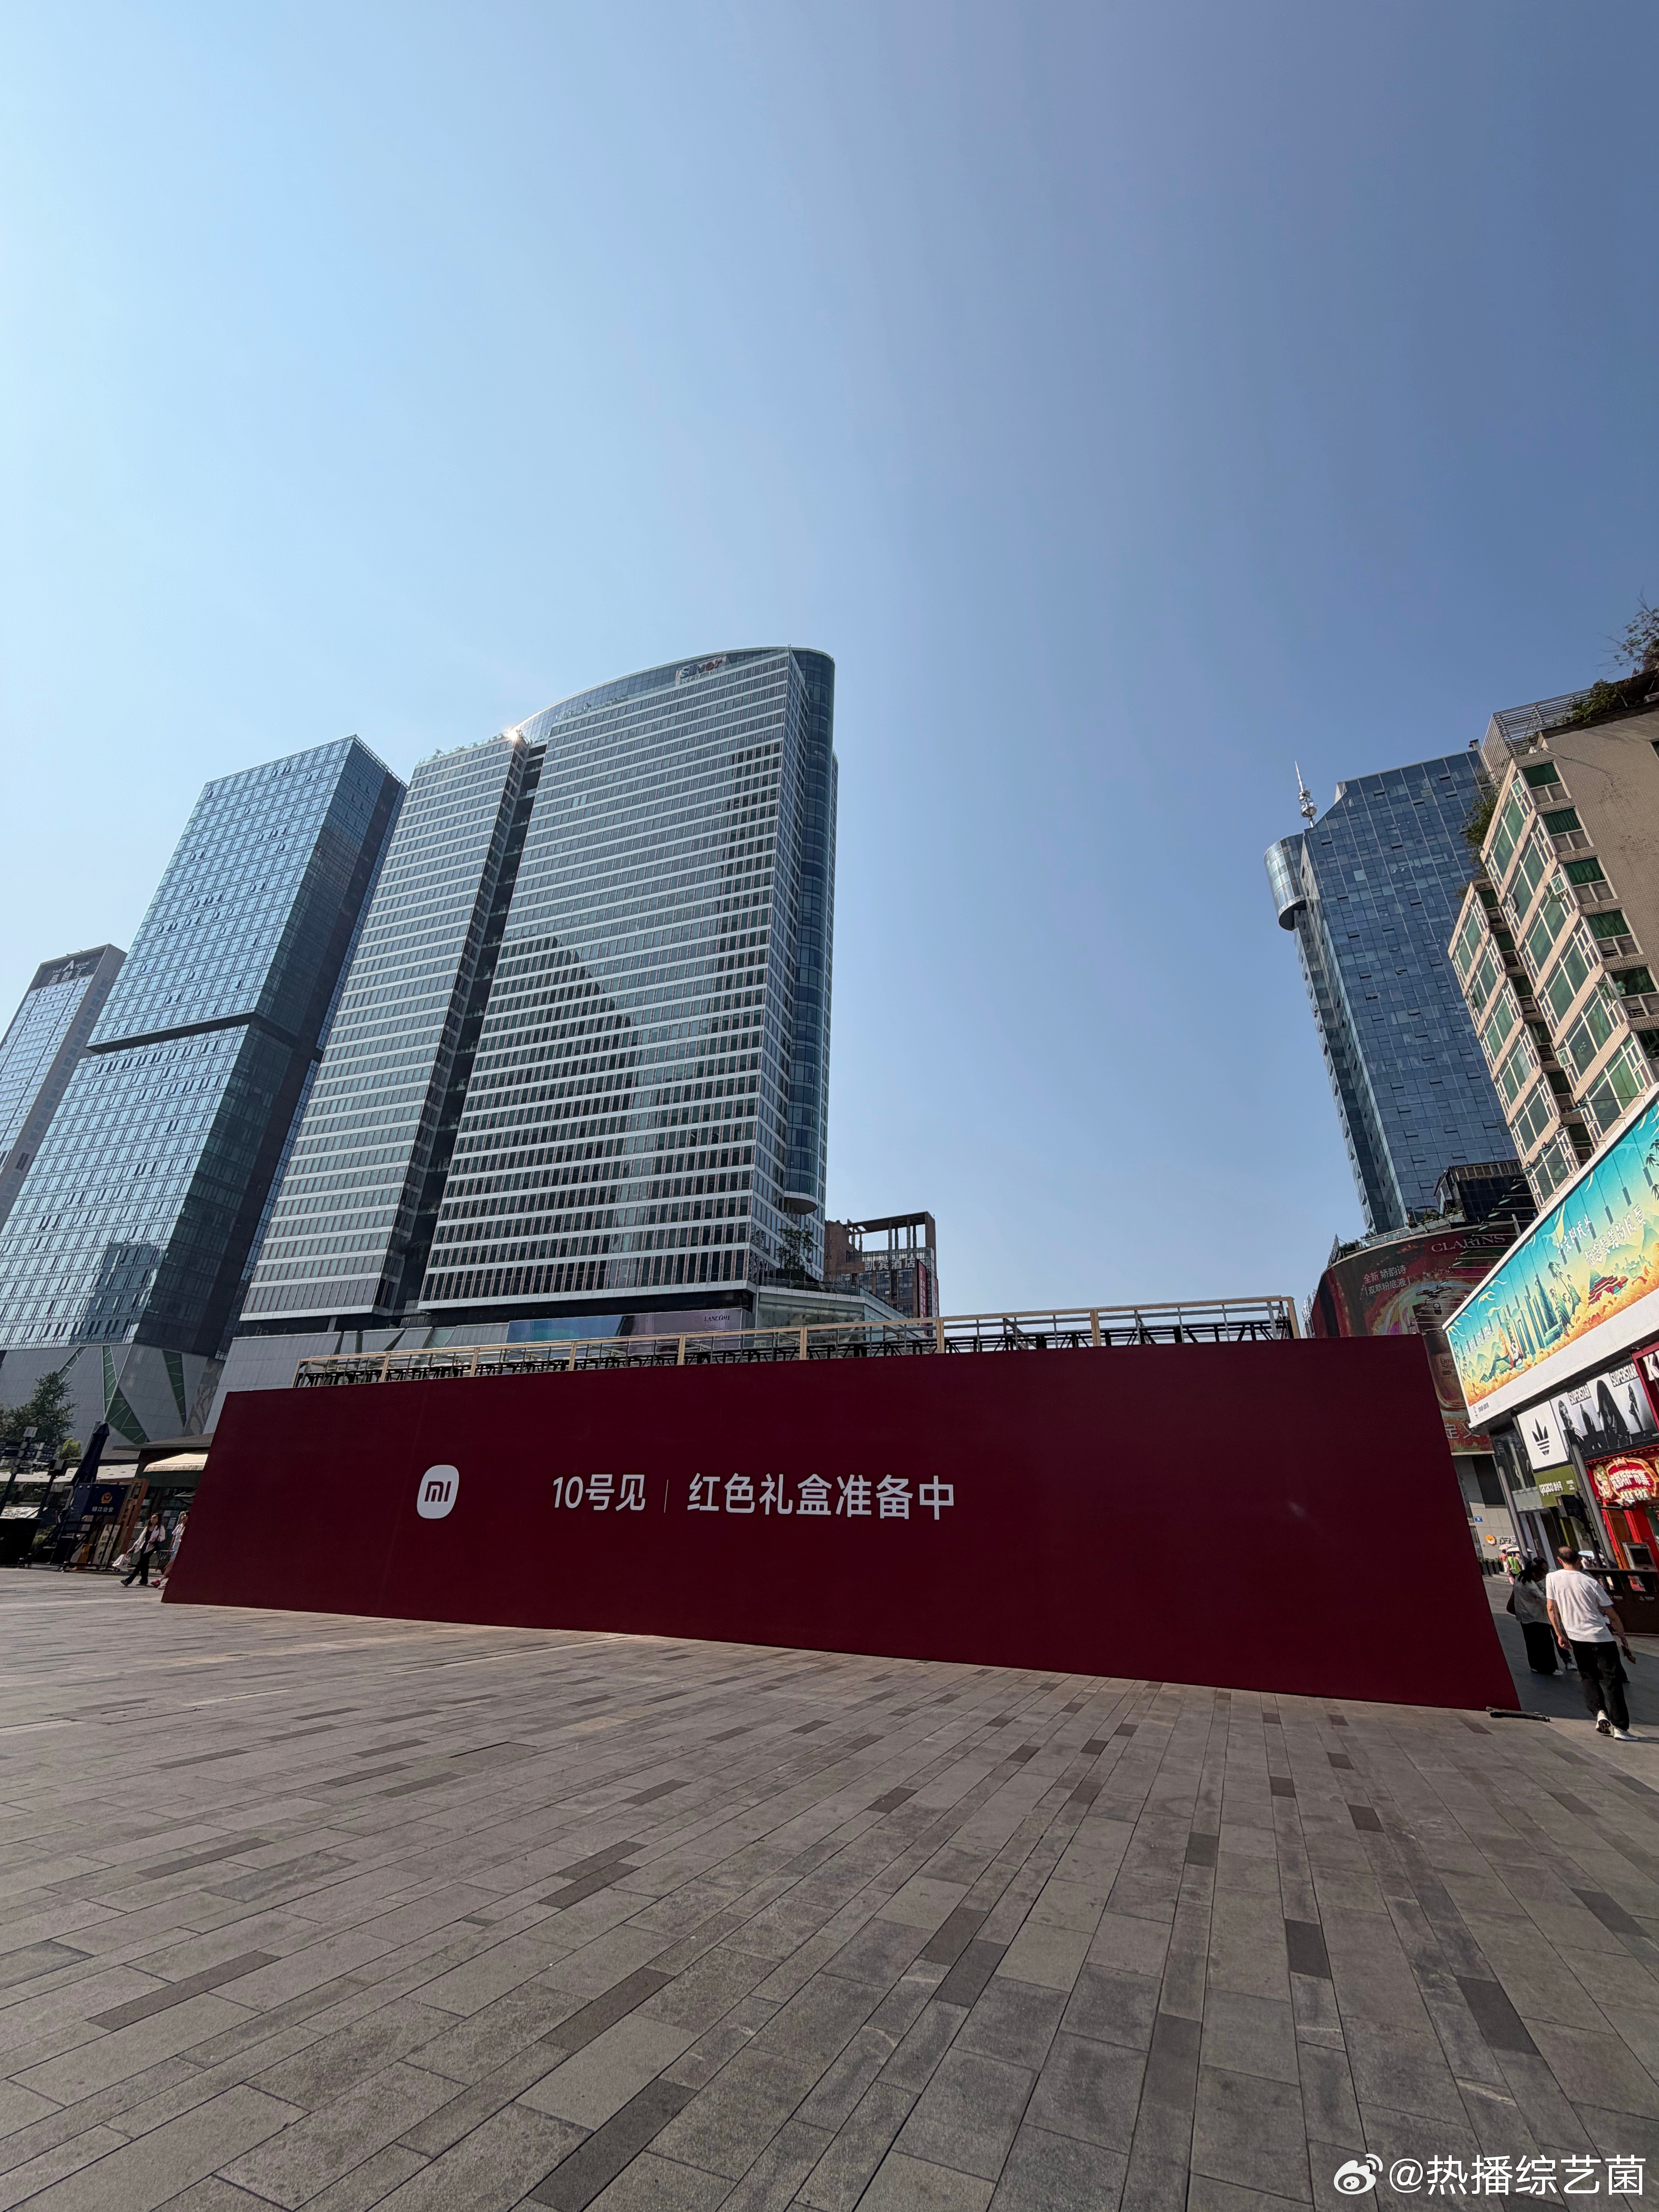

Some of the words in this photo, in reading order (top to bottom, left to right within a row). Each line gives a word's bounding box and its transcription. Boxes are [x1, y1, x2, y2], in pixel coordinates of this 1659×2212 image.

[1431, 1235, 1506, 1252] CLARINS
[1363, 1272, 1379, 1284] 全新
[1379, 1264, 1407, 1280] 娇韵诗
[1609, 1363, 1638, 1386] SUPERSTAR
[1568, 1384, 1591, 1405] SUPERSTAR
[553, 1474, 646, 1511] 10号见
[687, 1473, 955, 1520] 红色礼盒准备中
